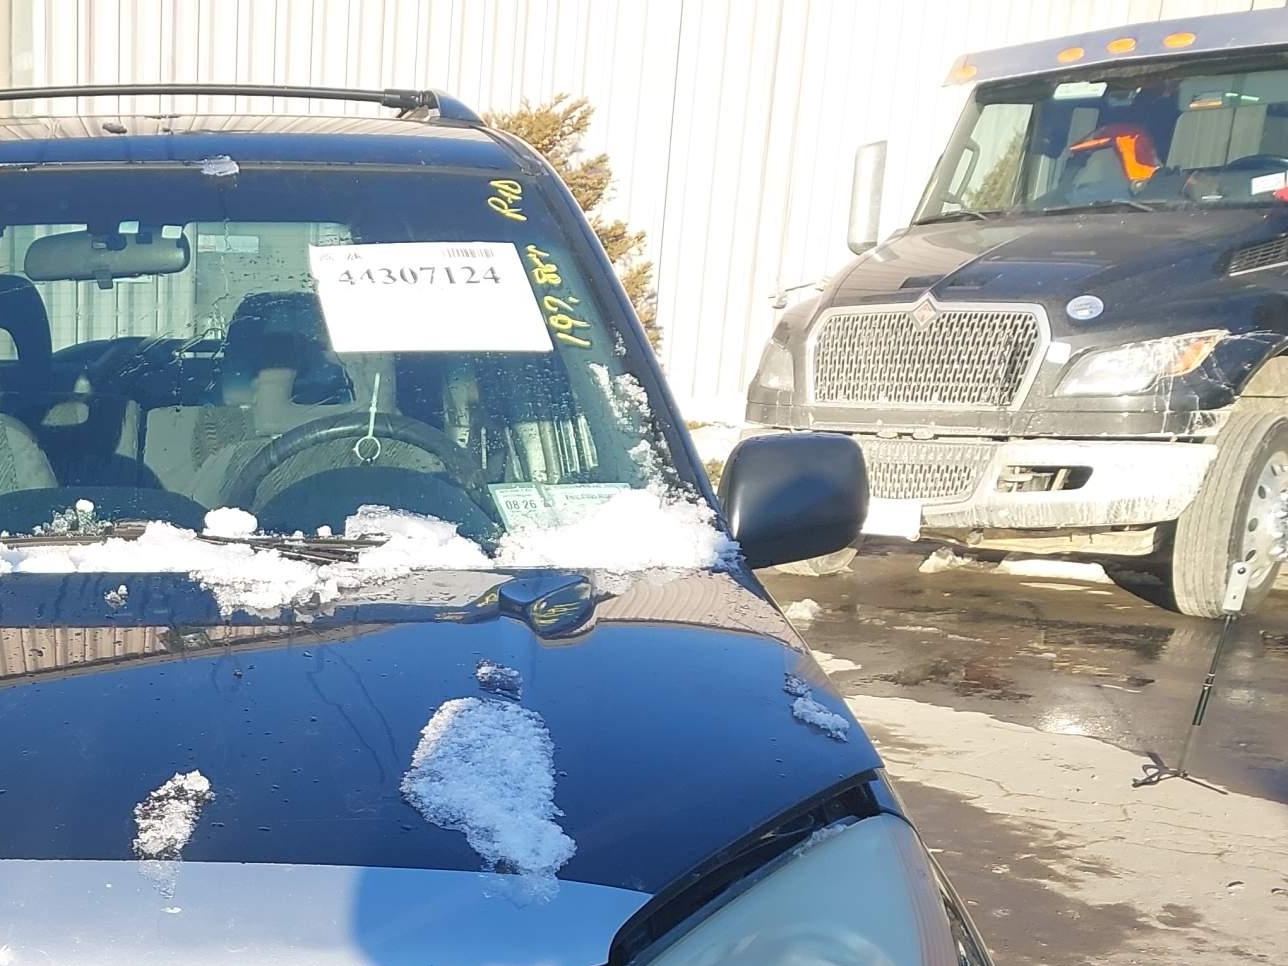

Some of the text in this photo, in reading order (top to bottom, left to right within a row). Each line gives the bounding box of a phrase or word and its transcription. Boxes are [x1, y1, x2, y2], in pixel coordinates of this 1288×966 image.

[338, 265, 502, 286] 44307124
[505, 498, 537, 511] 08 26
